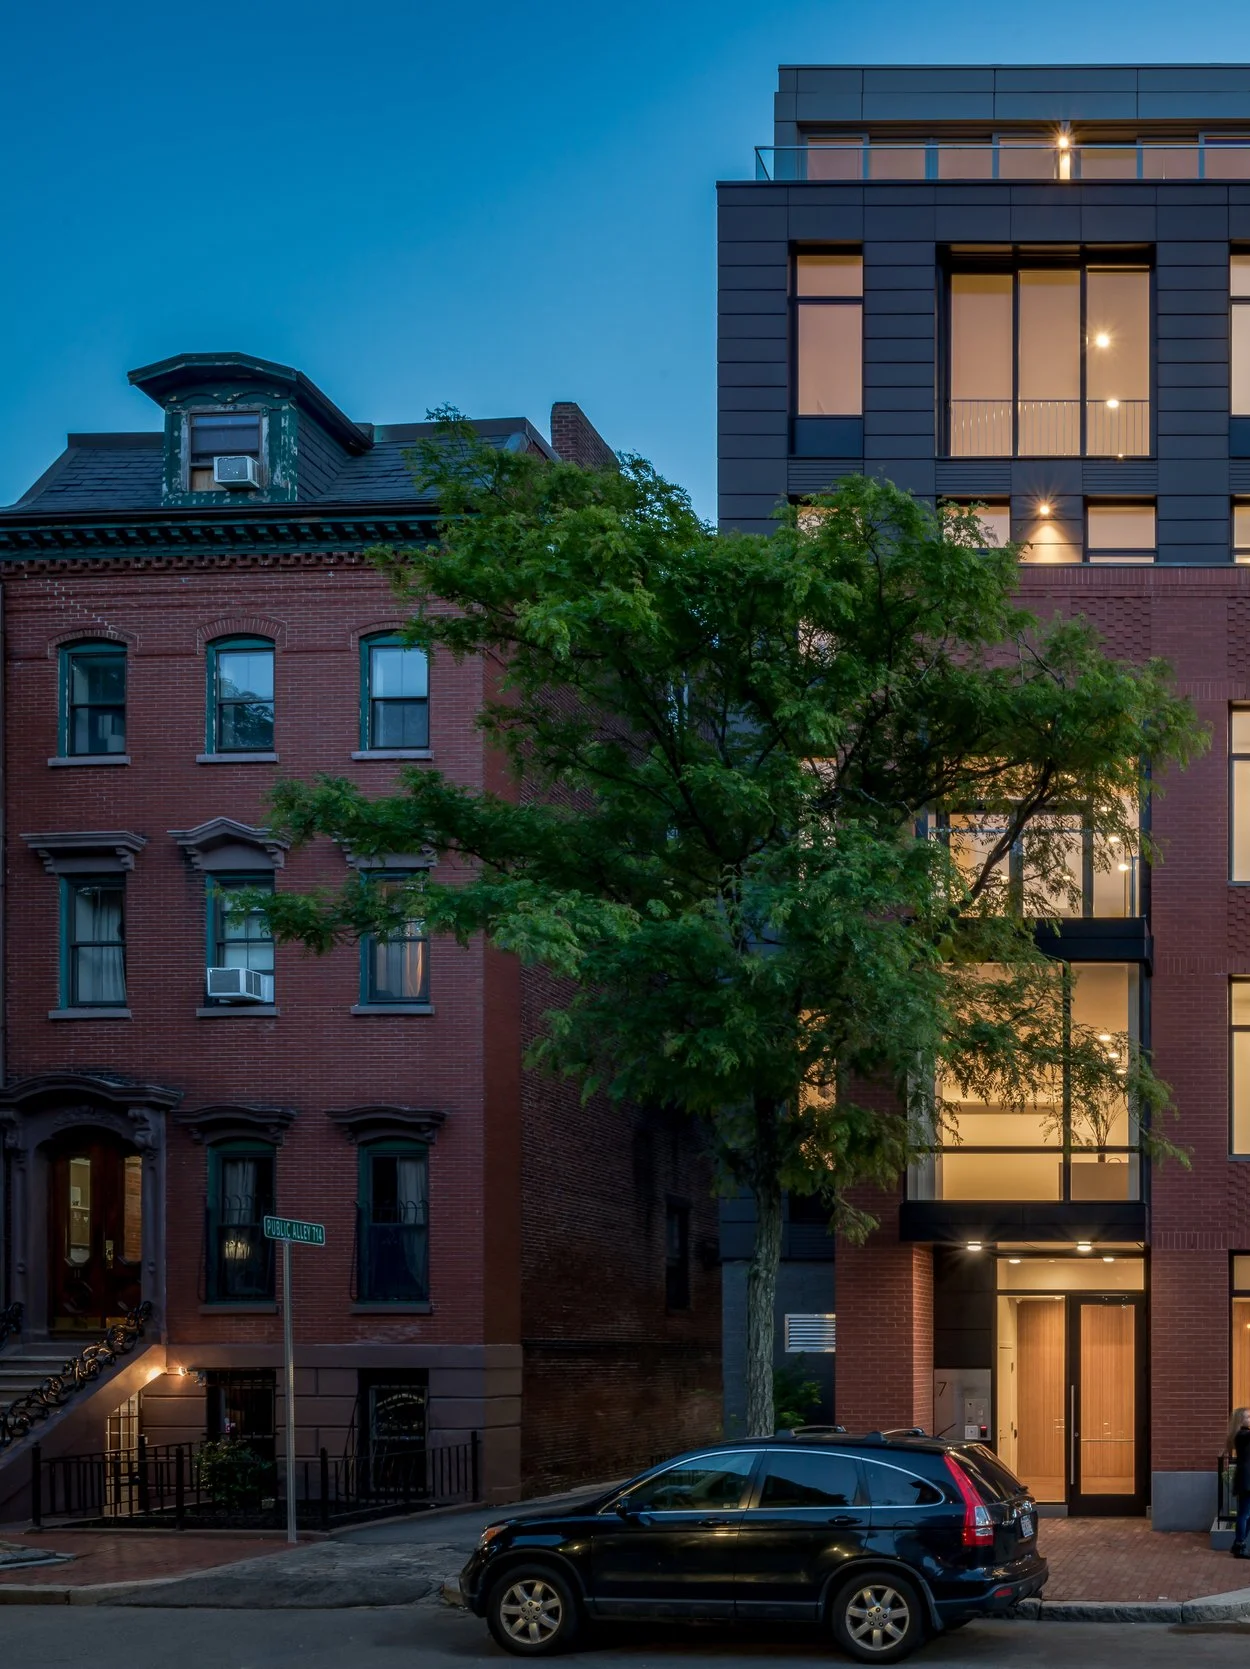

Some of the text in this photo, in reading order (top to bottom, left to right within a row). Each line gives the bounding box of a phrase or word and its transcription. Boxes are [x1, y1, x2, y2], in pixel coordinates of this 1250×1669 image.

[266, 1219, 323, 1242] PUBLIC ALLEY 714
[936, 1381, 948, 1397] 7
